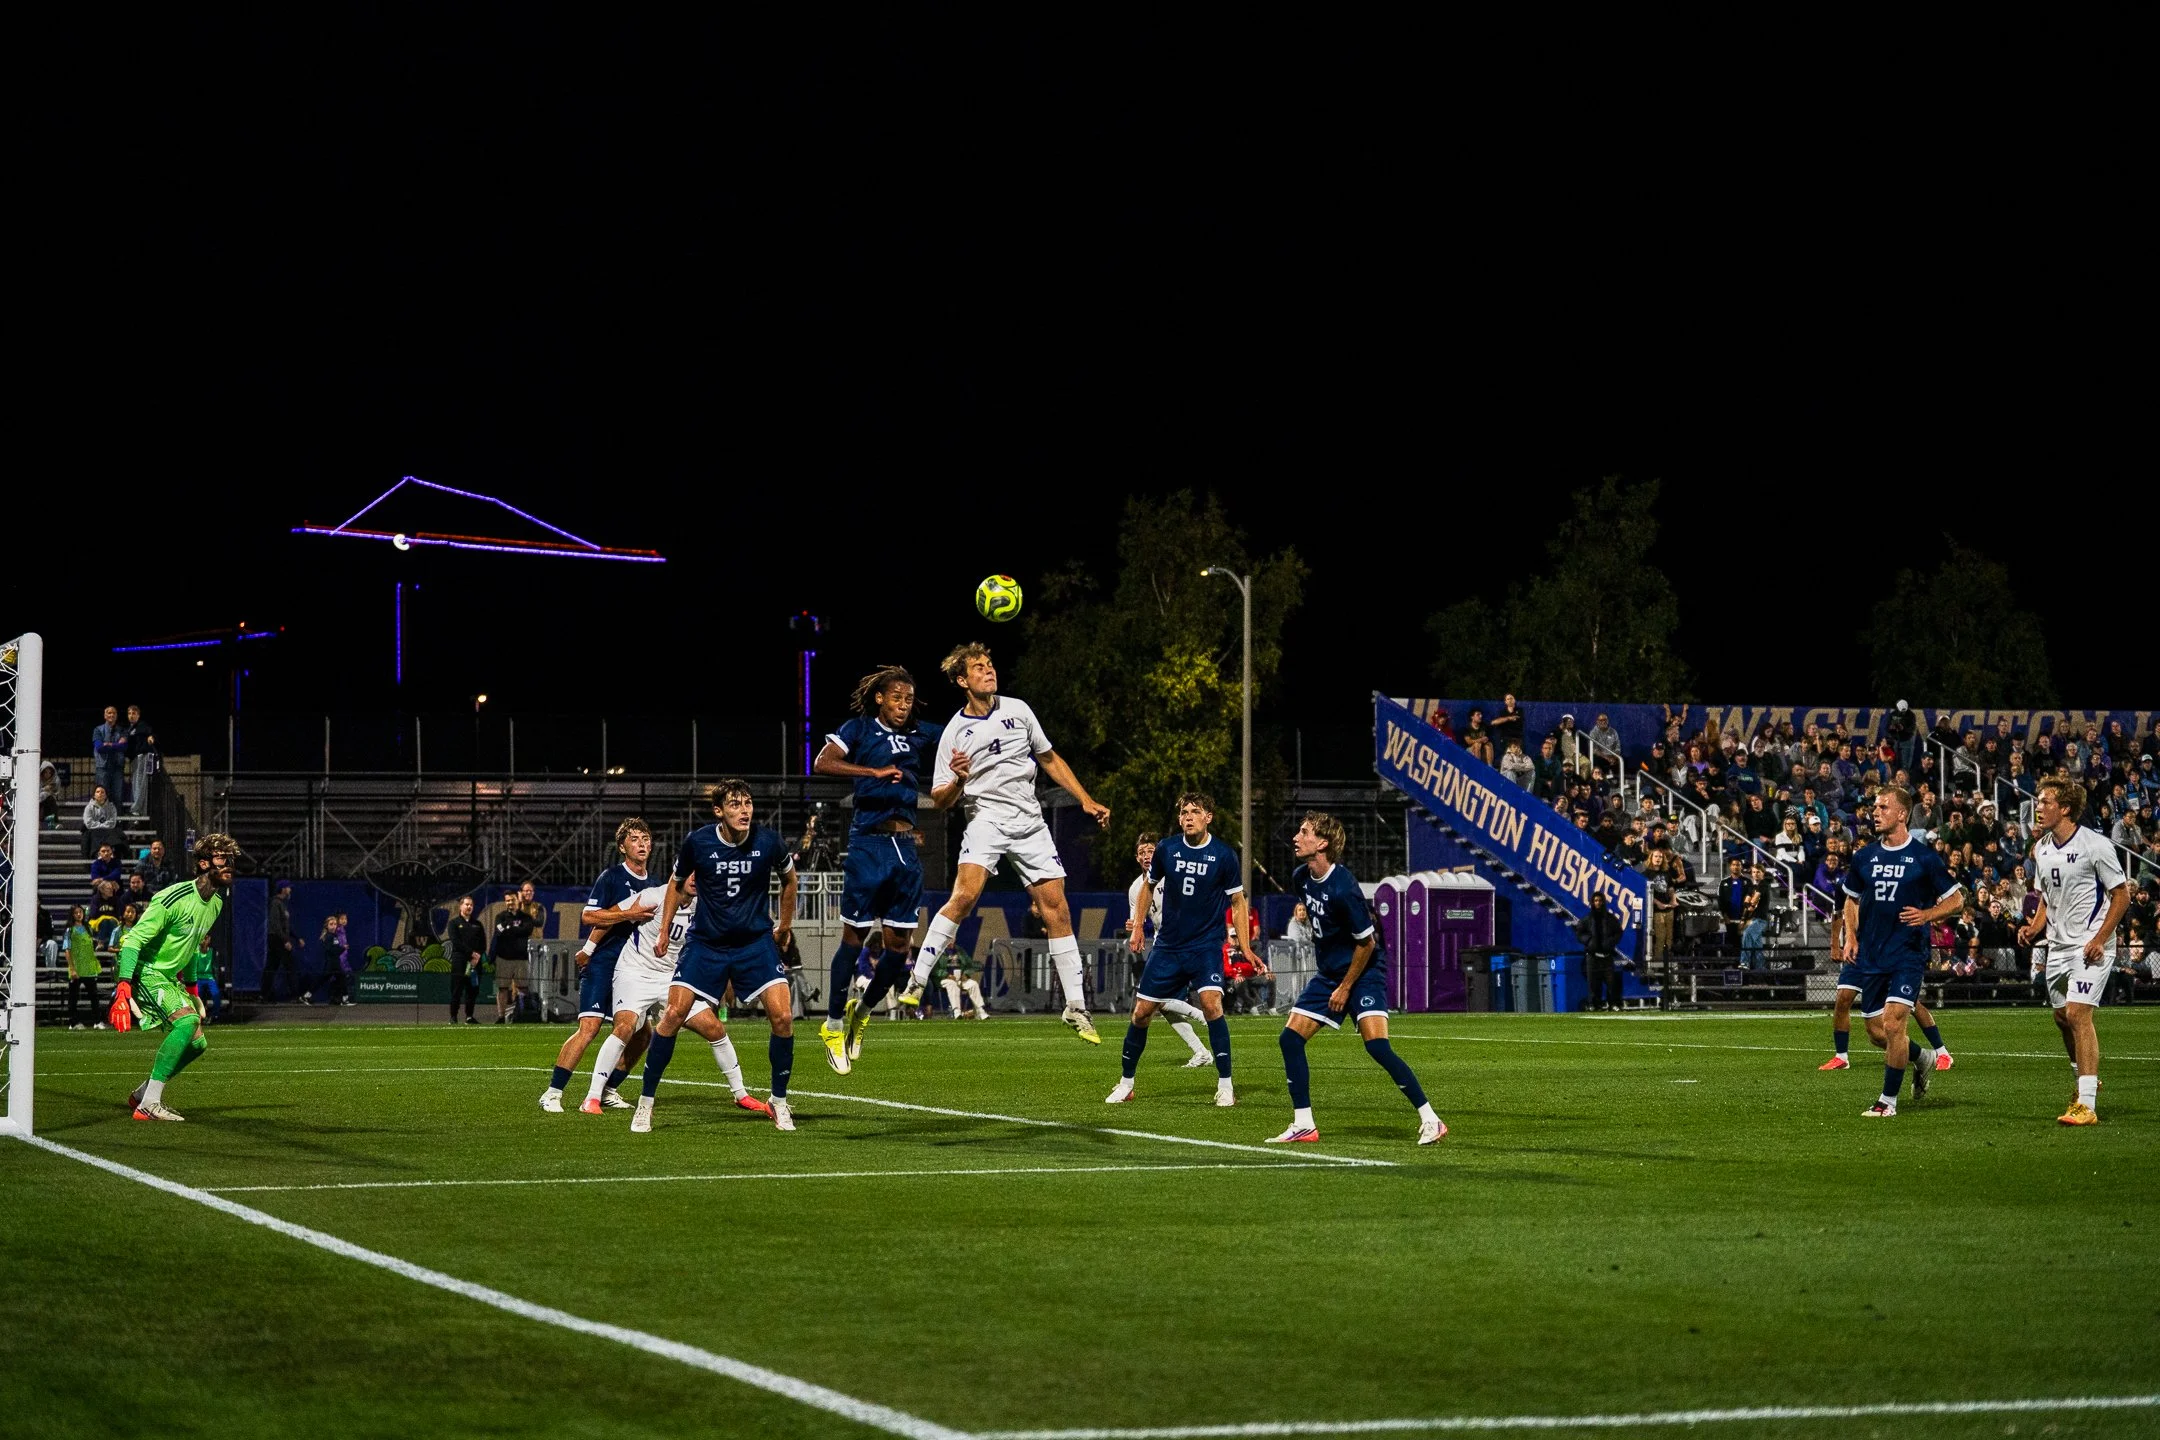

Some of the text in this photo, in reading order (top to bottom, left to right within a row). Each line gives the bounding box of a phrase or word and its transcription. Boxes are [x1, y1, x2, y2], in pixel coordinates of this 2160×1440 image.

[1001, 717, 1015, 730] W
[1706, 706, 2110, 752] WASHNGTON
[886, 734, 911, 754] 16
[989, 738, 1001, 755] 4
[1384, 720, 1636, 932] WASHINGTON HUSKIES
[2066, 853, 2078, 864] W
[715, 861, 753, 875] PSU
[1174, 860, 1209, 876] PSU
[1871, 864, 1906, 879] PSU
[2051, 868, 2061, 887] 9
[726, 877, 741, 898] 5
[1182, 876, 1196, 897] 6
[1874, 880, 1899, 902] 27
[360, 982, 417, 992] Husky Promise
[2076, 981, 2094, 995] W
